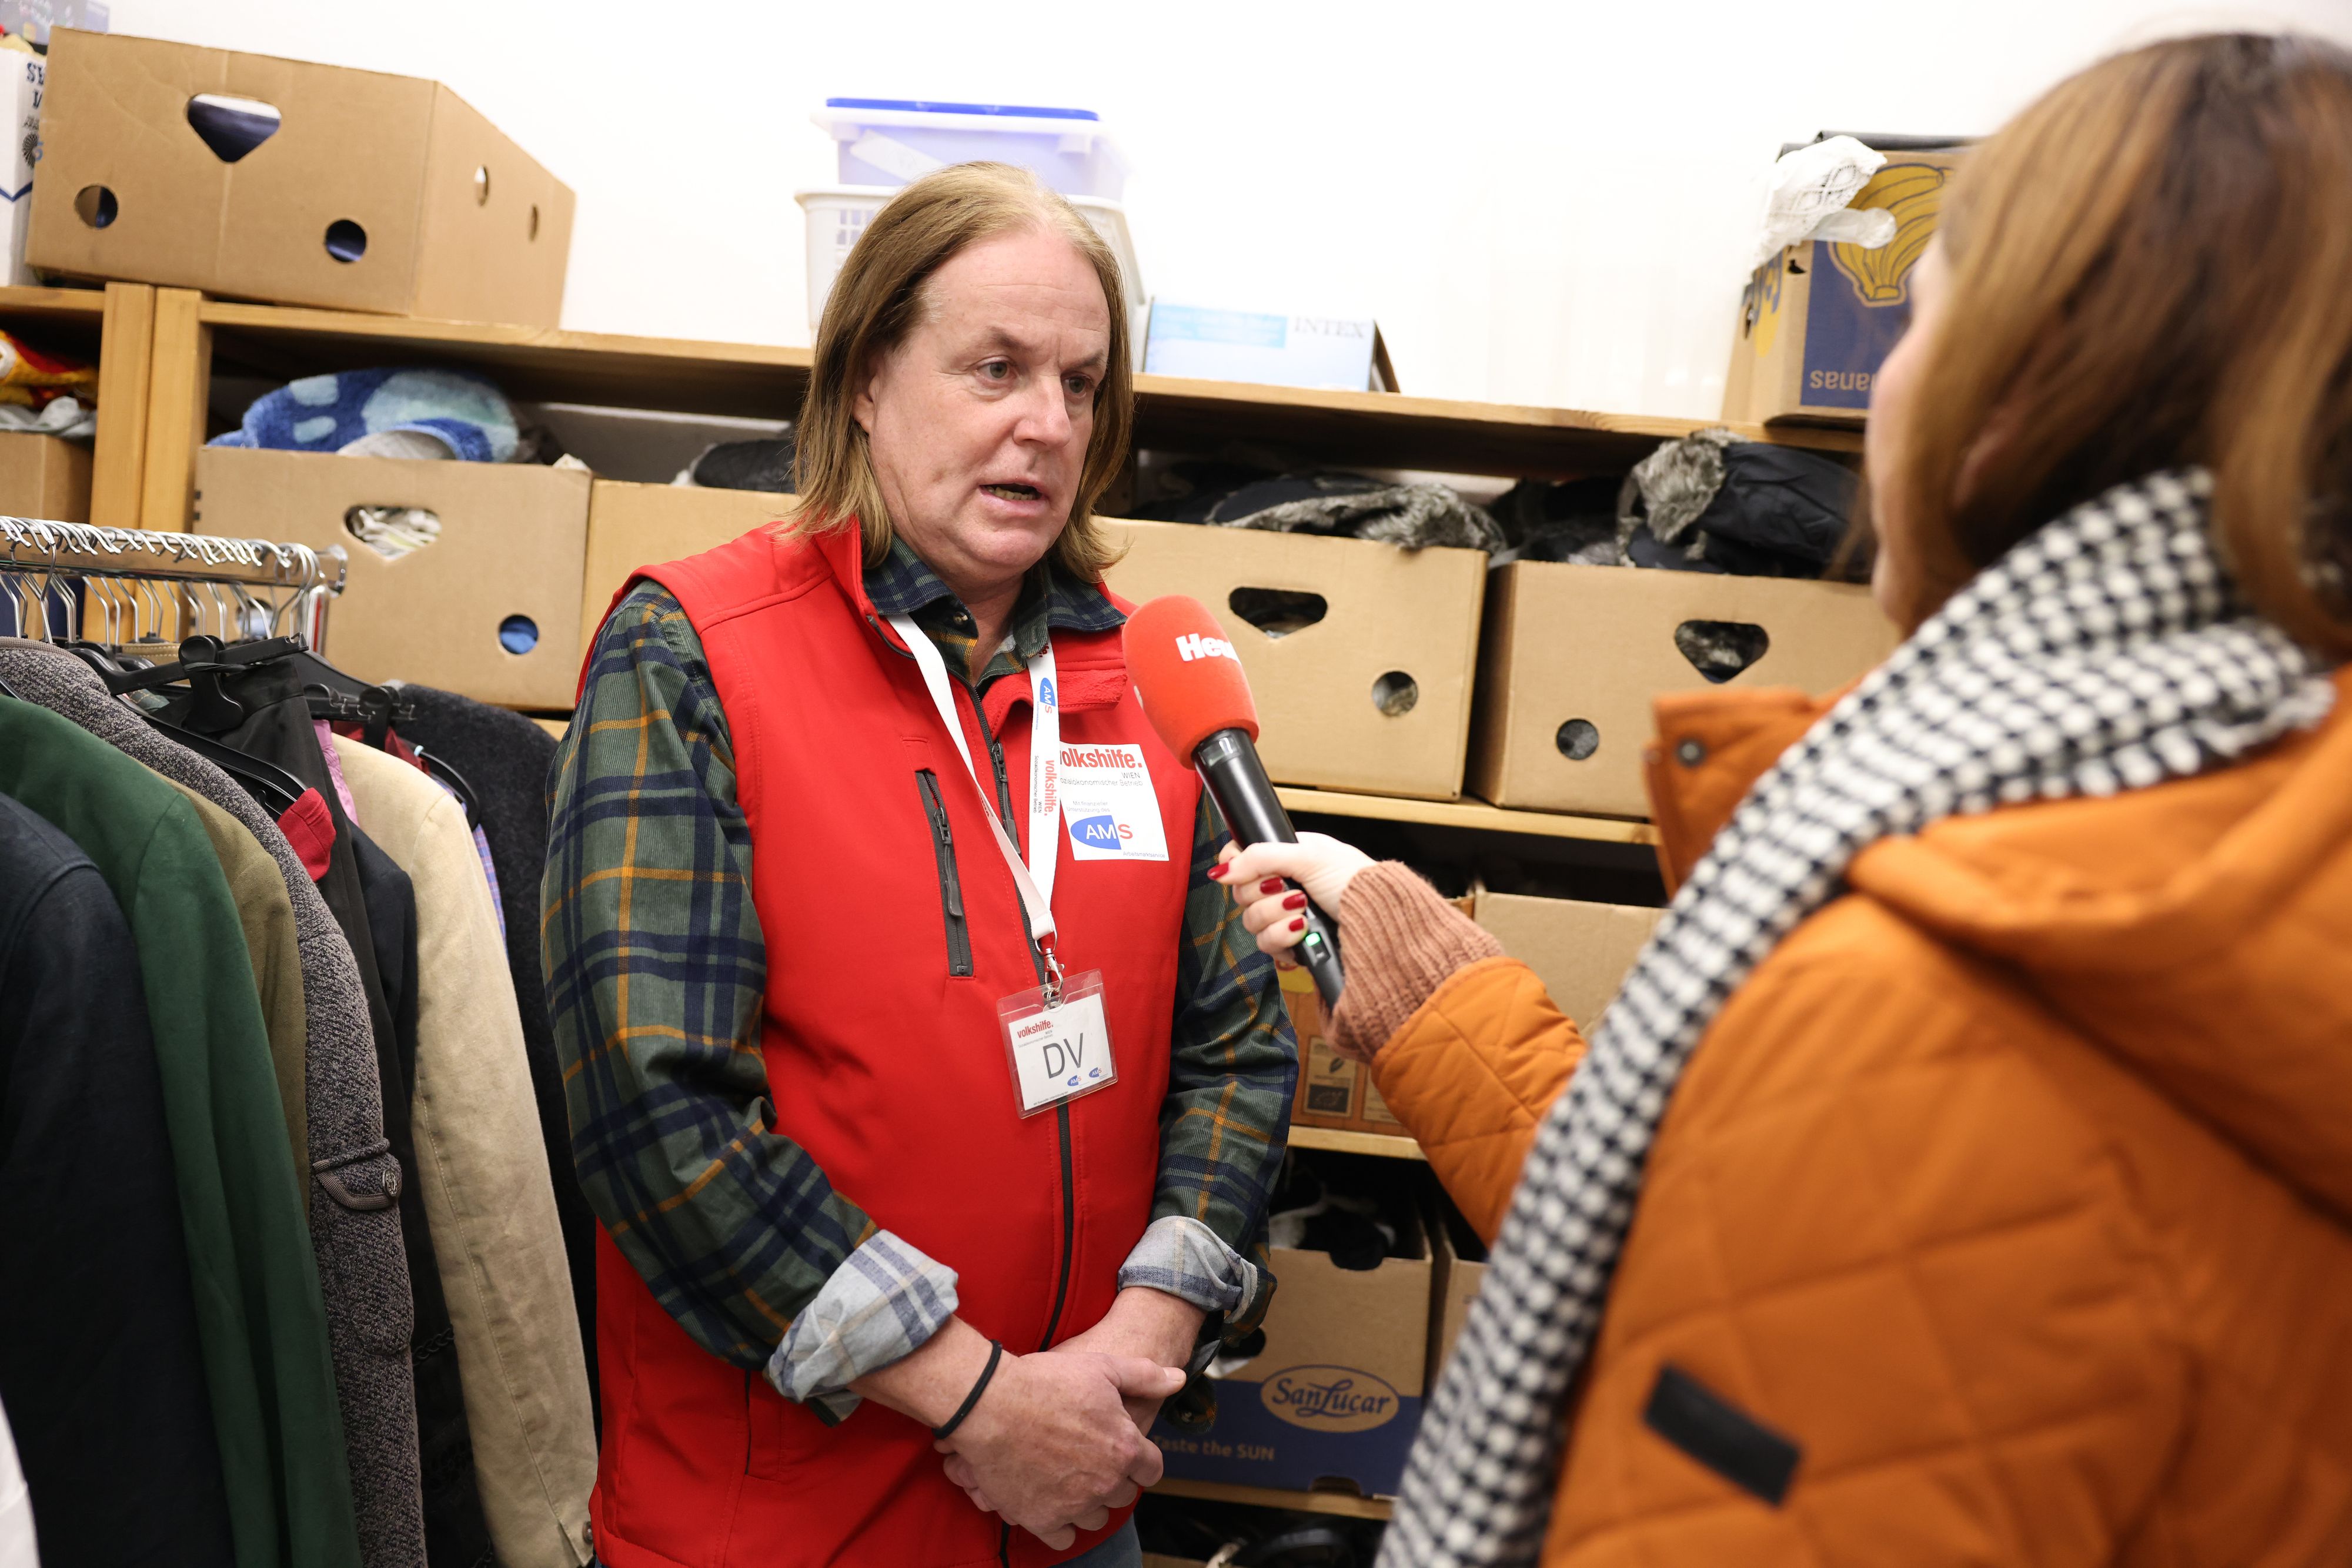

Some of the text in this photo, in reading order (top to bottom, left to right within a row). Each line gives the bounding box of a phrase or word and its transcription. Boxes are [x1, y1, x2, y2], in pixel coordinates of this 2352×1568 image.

[1295, 316, 1365, 339] INTEX
[1809, 369, 1877, 392] anas
[1043, 685, 1053, 714] AMS
[1060, 748, 1143, 768] olkshilfe.
[1044, 760, 1057, 816] volkshilfe.
[1060, 778, 1118, 786] ozialökonomischer
[1086, 824, 1133, 840] AMS
[1017, 1019, 1054, 1038] volkshilfe.
[1043, 1032, 1084, 1079] DV
[1272, 1378, 1391, 1418] SanLucar
[1202, 1440, 1233, 1457] the
[1237, 1443, 1275, 1462] SUN
